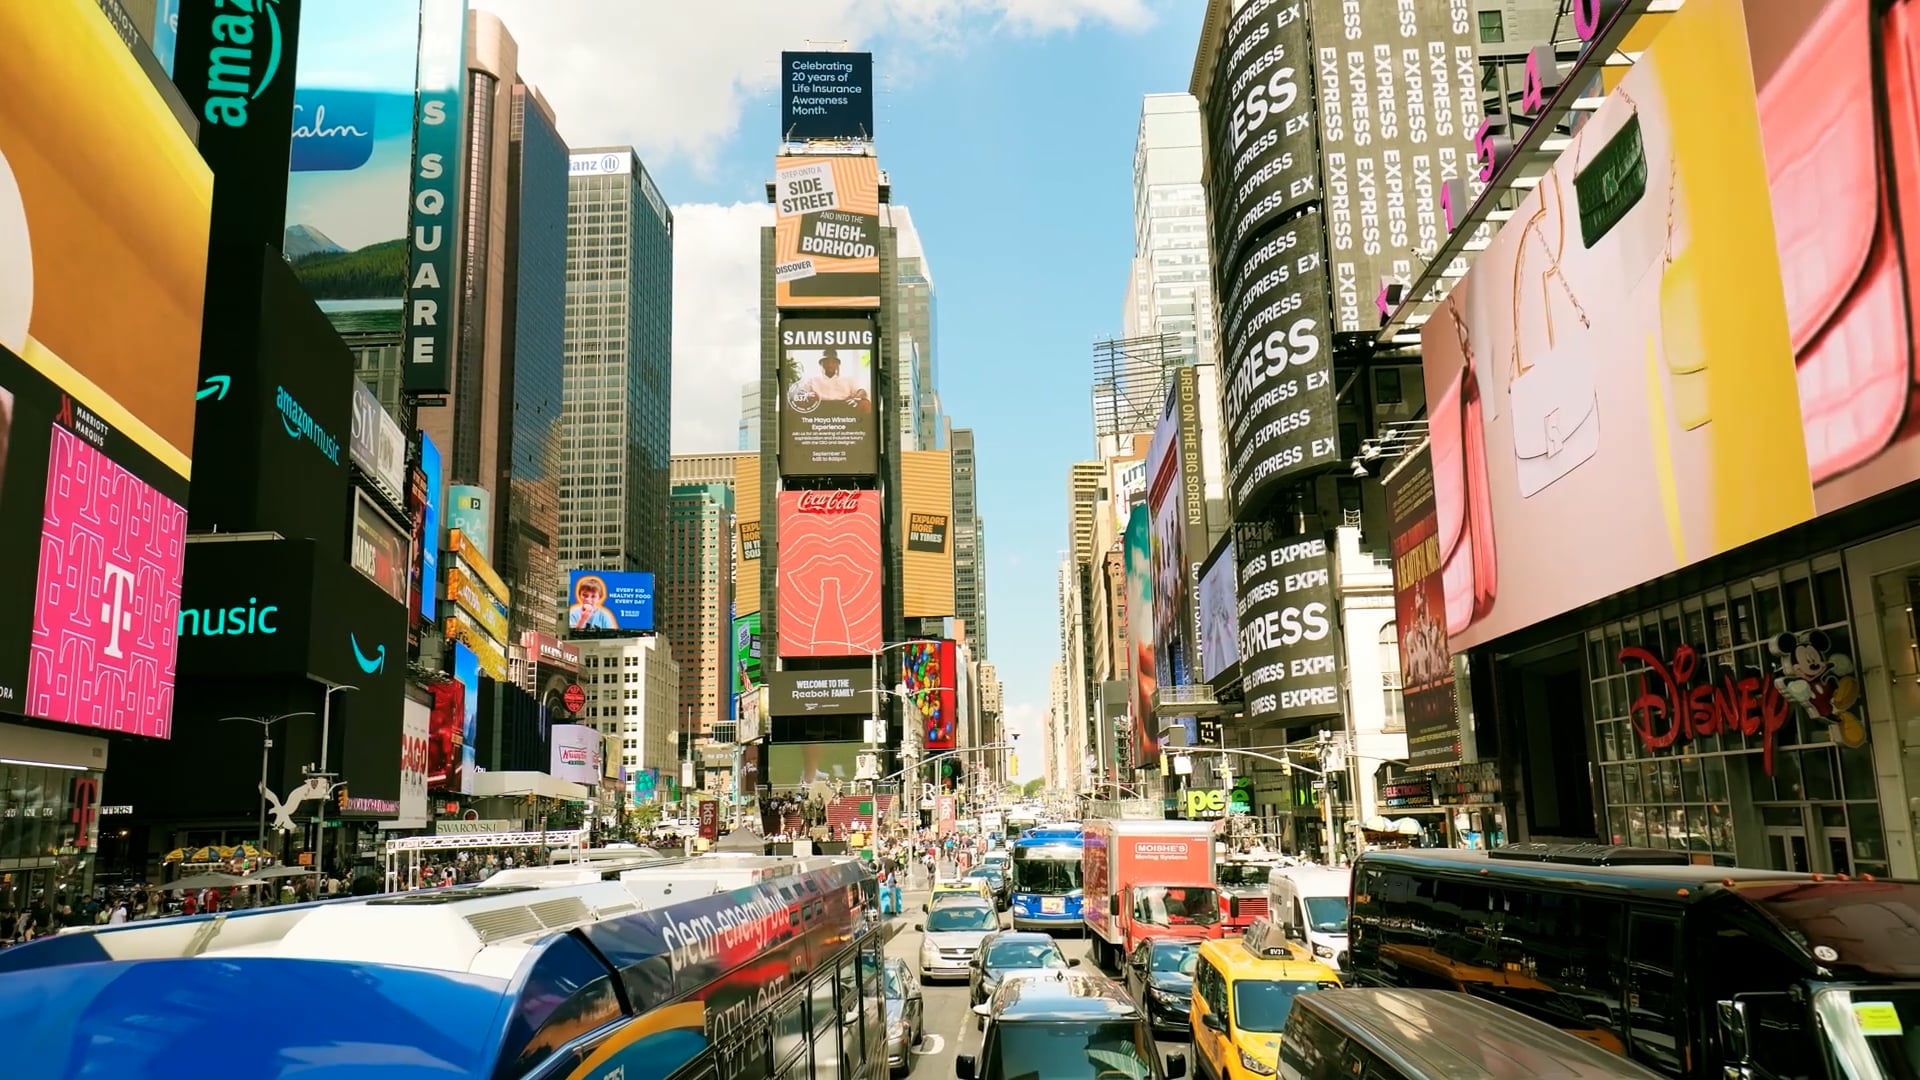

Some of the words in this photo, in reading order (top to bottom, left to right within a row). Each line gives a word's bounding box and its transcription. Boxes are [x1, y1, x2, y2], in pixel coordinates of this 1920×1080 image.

[1227, 23, 1269, 80] EXPRESS
[792, 61, 853, 73] Celebrating
[792, 72, 806, 82] 20
[808, 73, 835, 84] years
[837, 72, 848, 82] of
[1232, 44, 1284, 101] EXPRESS
[792, 83, 809, 93] Life
[812, 83, 862, 94] Insurance
[792, 96, 848, 105] Awareness
[1320, 47, 1343, 142] EXPRESS
[1347, 51, 1371, 146] EXPRESS
[1374, 44, 1398, 139] EXPRESS
[1402, 48, 1427, 144] EXPRESS
[1428, 42, 1453, 136] EXPRESS
[1455, 46, 1479, 141] EXPRESS
[792, 105, 828, 115] Month.
[1234, 129, 1278, 182] EXPRESS
[781, 171, 798, 179] STEP
[789, 177, 822, 196] SIDE
[1240, 152, 1293, 204] EXPRESS
[782, 191, 834, 214] STREET
[1329, 153, 1352, 250] EXPRESS
[1357, 158, 1381, 256] EXPRESS
[1384, 150, 1408, 248] EXPRESS
[820, 211, 834, 220] AND
[835, 213, 850, 222] INTO
[851, 215, 864, 224] THE
[1238, 191, 1282, 240] EXPRESS
[815, 222, 866, 242] NEIGH-
[412, 154, 446, 364] SQUARE
[802, 236, 875, 258] BORHOOD
[1244, 231, 1296, 279] EXPRESS
[776, 260, 812, 275] DISCOVER
[1243, 265, 1289, 311] EXPRESS
[1248, 293, 1302, 337] EXPRESS
[783, 330, 873, 346] SAMSUNG
[1227, 319, 1319, 432] EXPRESS
[1182, 404, 1195, 422] ON
[1251, 380, 1298, 420] EXPRESS
[75, 421, 104, 447] MARQUIS
[76, 406, 109, 436] MARRIOTT
[276, 385, 313, 440] amazon
[314, 423, 340, 466] music
[1256, 409, 1311, 448] EXPRESS
[1184, 424, 1197, 453] THE
[1185, 453, 1199, 474] BIG
[1255, 446, 1303, 483] EXPRESS
[797, 489, 859, 511] Coca-Cola
[1186, 476, 1201, 525] SCREEN
[911, 523, 933, 533] MORE
[912, 514, 945, 526] EXPLORE
[744, 541, 752, 550] IN
[911, 532, 919, 541] IN
[920, 533, 942, 543] TIMES
[1247, 579, 1279, 608] EXPRESS
[178, 597, 277, 636] music
[1240, 602, 1329, 663] EXPRESS
[796, 680, 828, 689] WELCOME
[829, 680, 837, 688] TO
[838, 679, 849, 687] THE
[1251, 663, 1284, 689] EXPRESS
[792, 690, 829, 699] Reebok
[831, 688, 855, 697] FAMILY
[437, 823, 496, 833] SWAROVSKI
[703, 802, 714, 825] tkts
[662, 897, 767, 974] clean-energy
